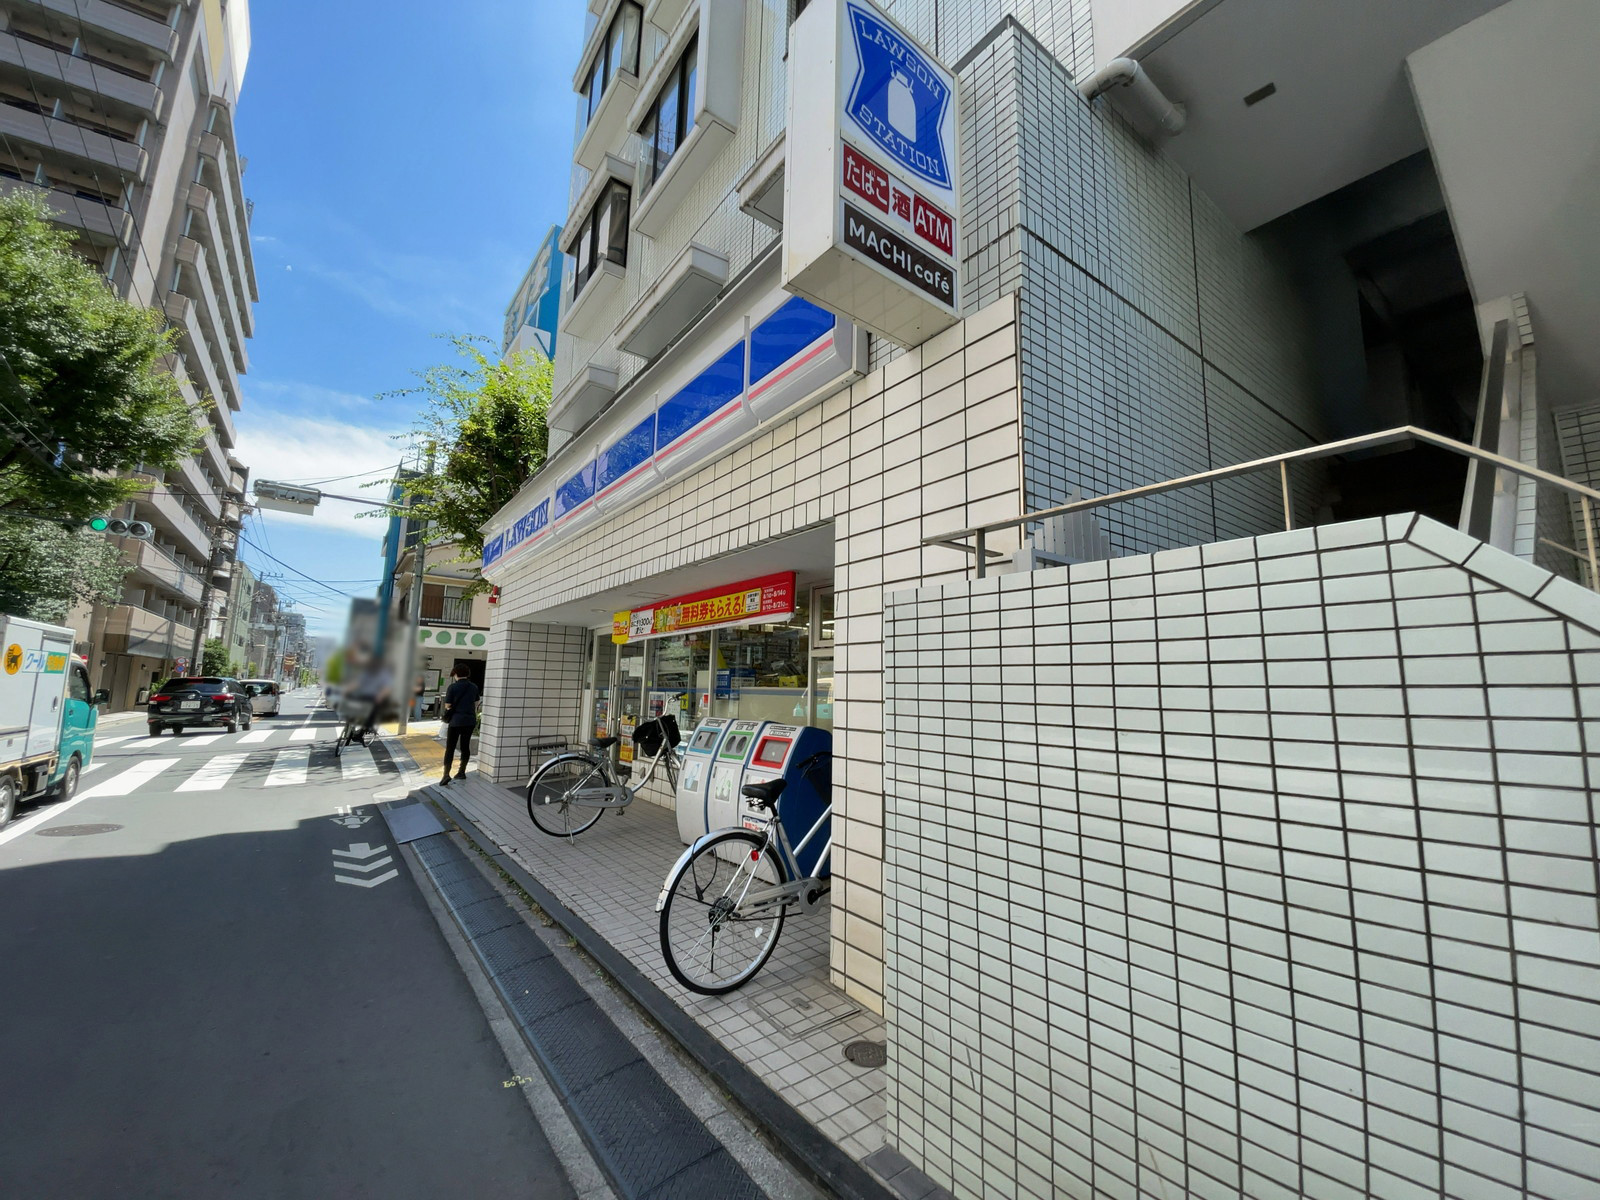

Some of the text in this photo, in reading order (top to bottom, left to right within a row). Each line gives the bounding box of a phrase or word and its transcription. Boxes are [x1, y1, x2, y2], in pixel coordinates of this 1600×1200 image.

[859, 18, 942, 100] LAWSON
[859, 103, 941, 176] STATION
[847, 155, 951, 248] たばこ 酒 ATM
[849, 217, 950, 294] MACHI café
[504, 497, 551, 553] LAWSON
